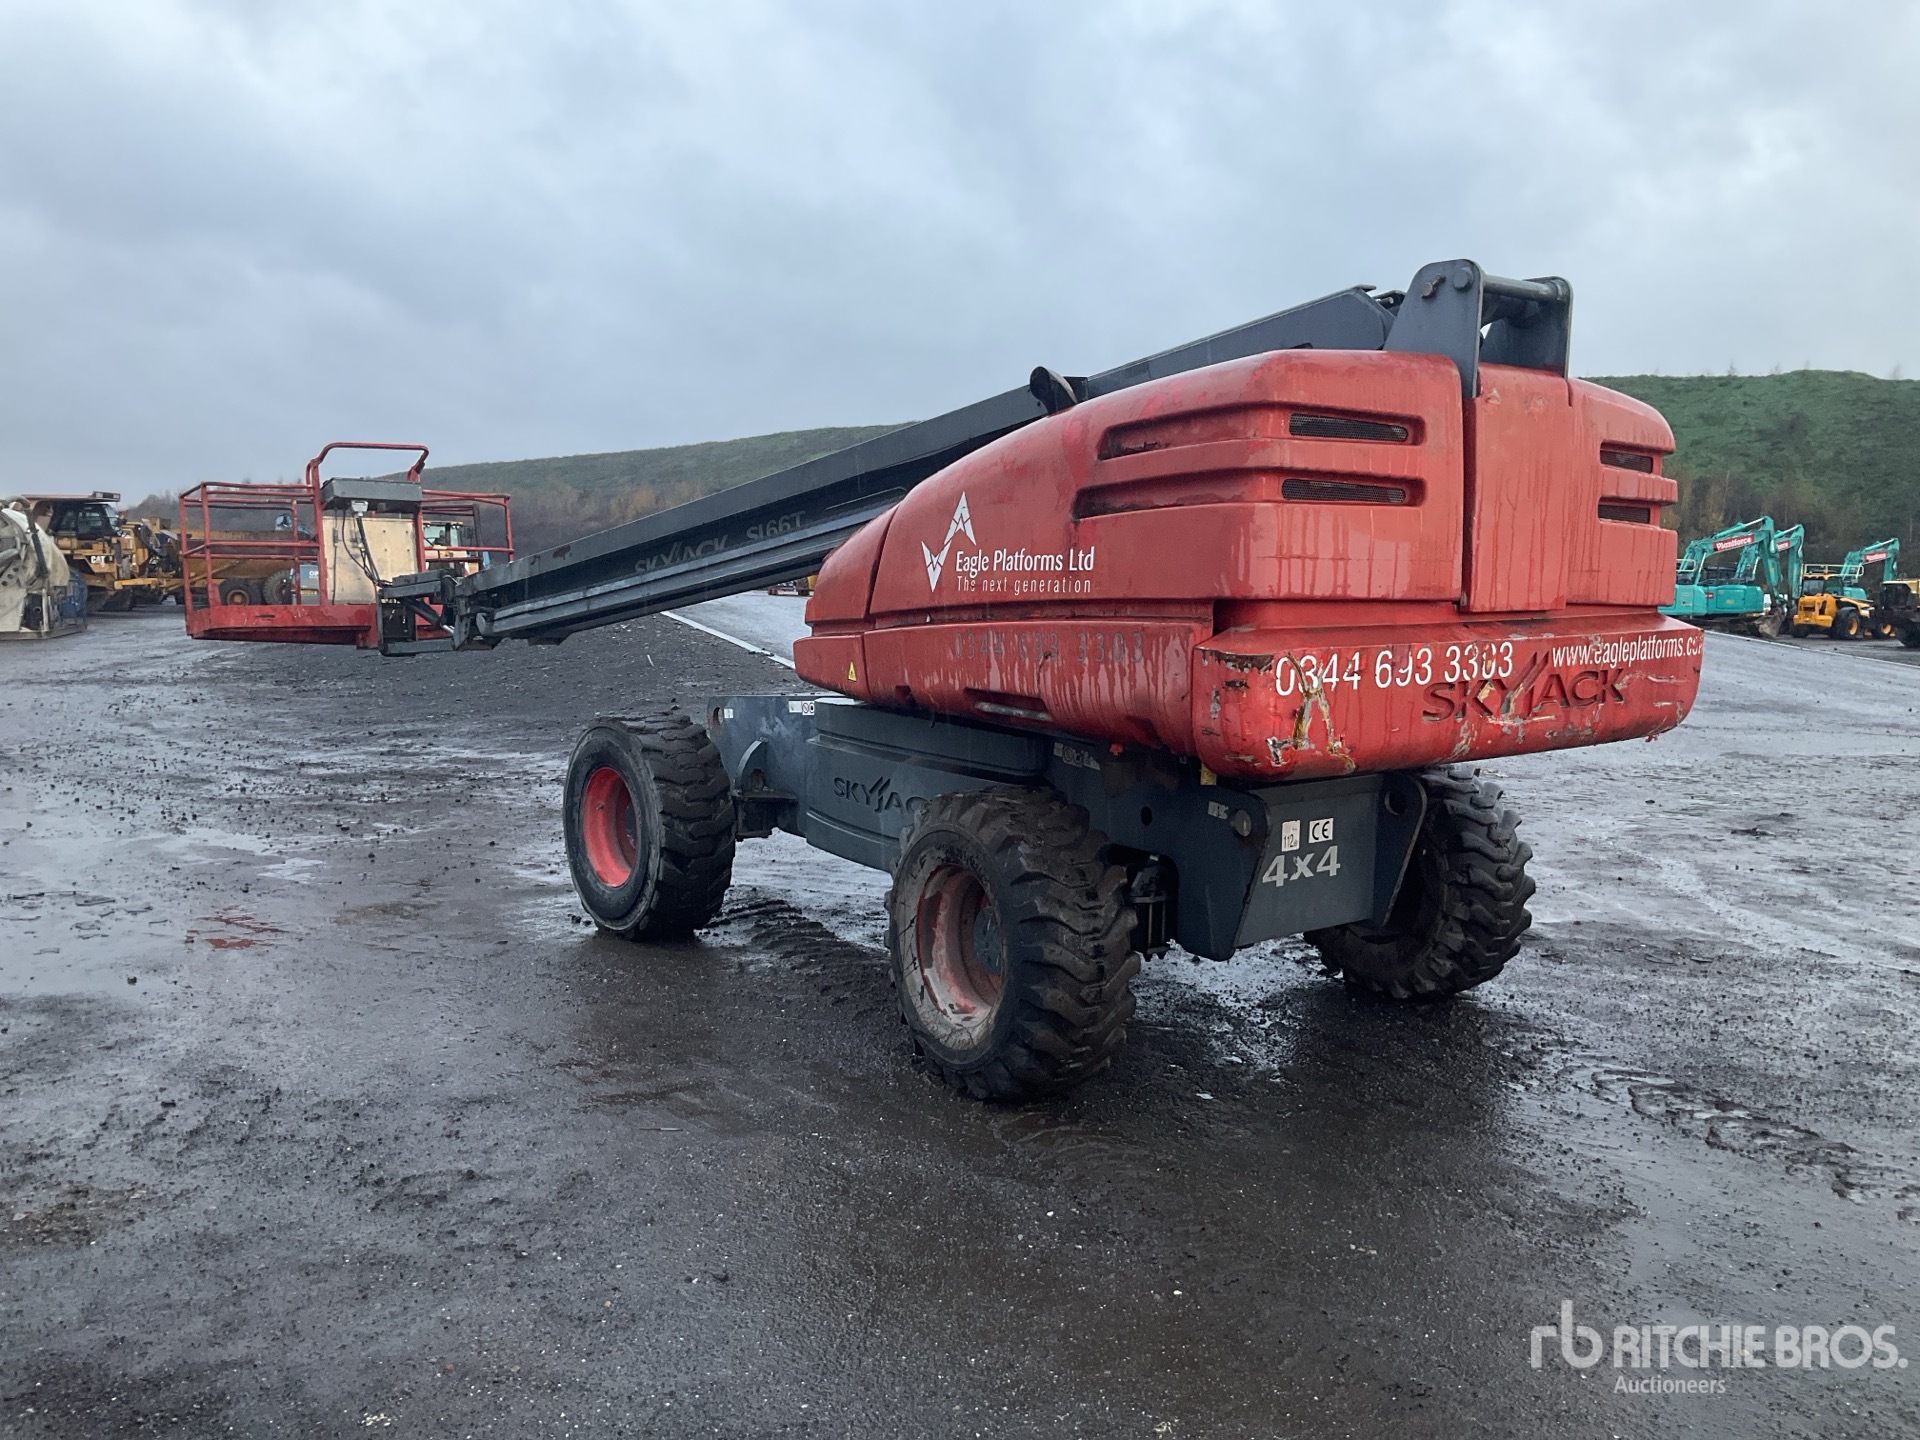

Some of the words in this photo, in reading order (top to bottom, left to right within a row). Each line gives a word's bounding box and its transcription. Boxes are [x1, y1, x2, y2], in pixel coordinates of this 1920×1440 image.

[90, 555, 106, 564] CAT
[956, 549, 989, 577] Eagle
[993, 548, 1063, 571] Platforms
[1069, 546, 1095, 571] Ltd
[957, 576, 976, 592] The
[982, 577, 1008, 592] next
[1014, 576, 1091, 596] generation
[1421, 651, 1626, 722] SKYJACK
[833, 776, 930, 815] SKYJAC
